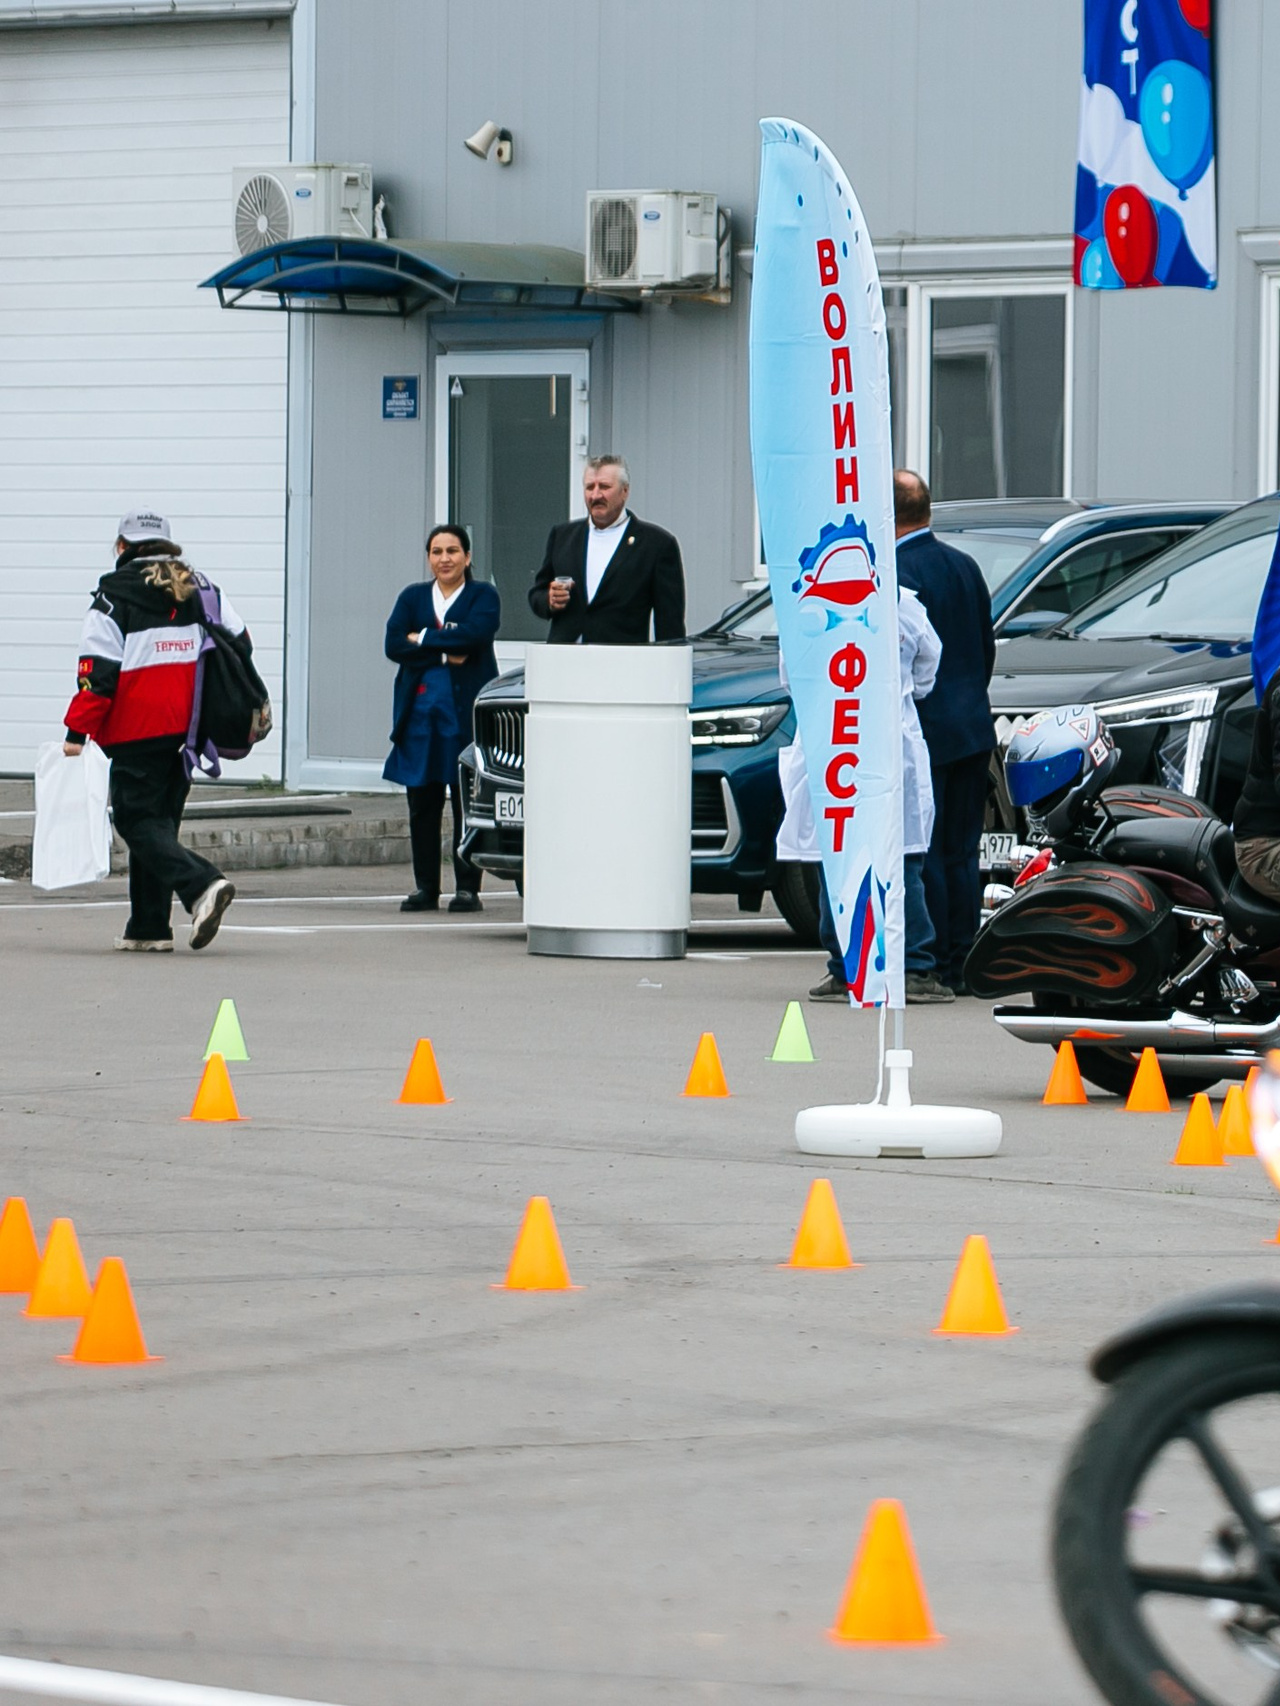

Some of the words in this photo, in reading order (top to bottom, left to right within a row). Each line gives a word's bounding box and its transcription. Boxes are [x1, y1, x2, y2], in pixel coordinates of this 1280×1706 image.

[816, 238, 859, 504] ВОЛИН
[155, 638, 194, 652] Ferrari
[824, 642, 867, 852] ФЕСТ
[990, 836, 1013, 853] 977
